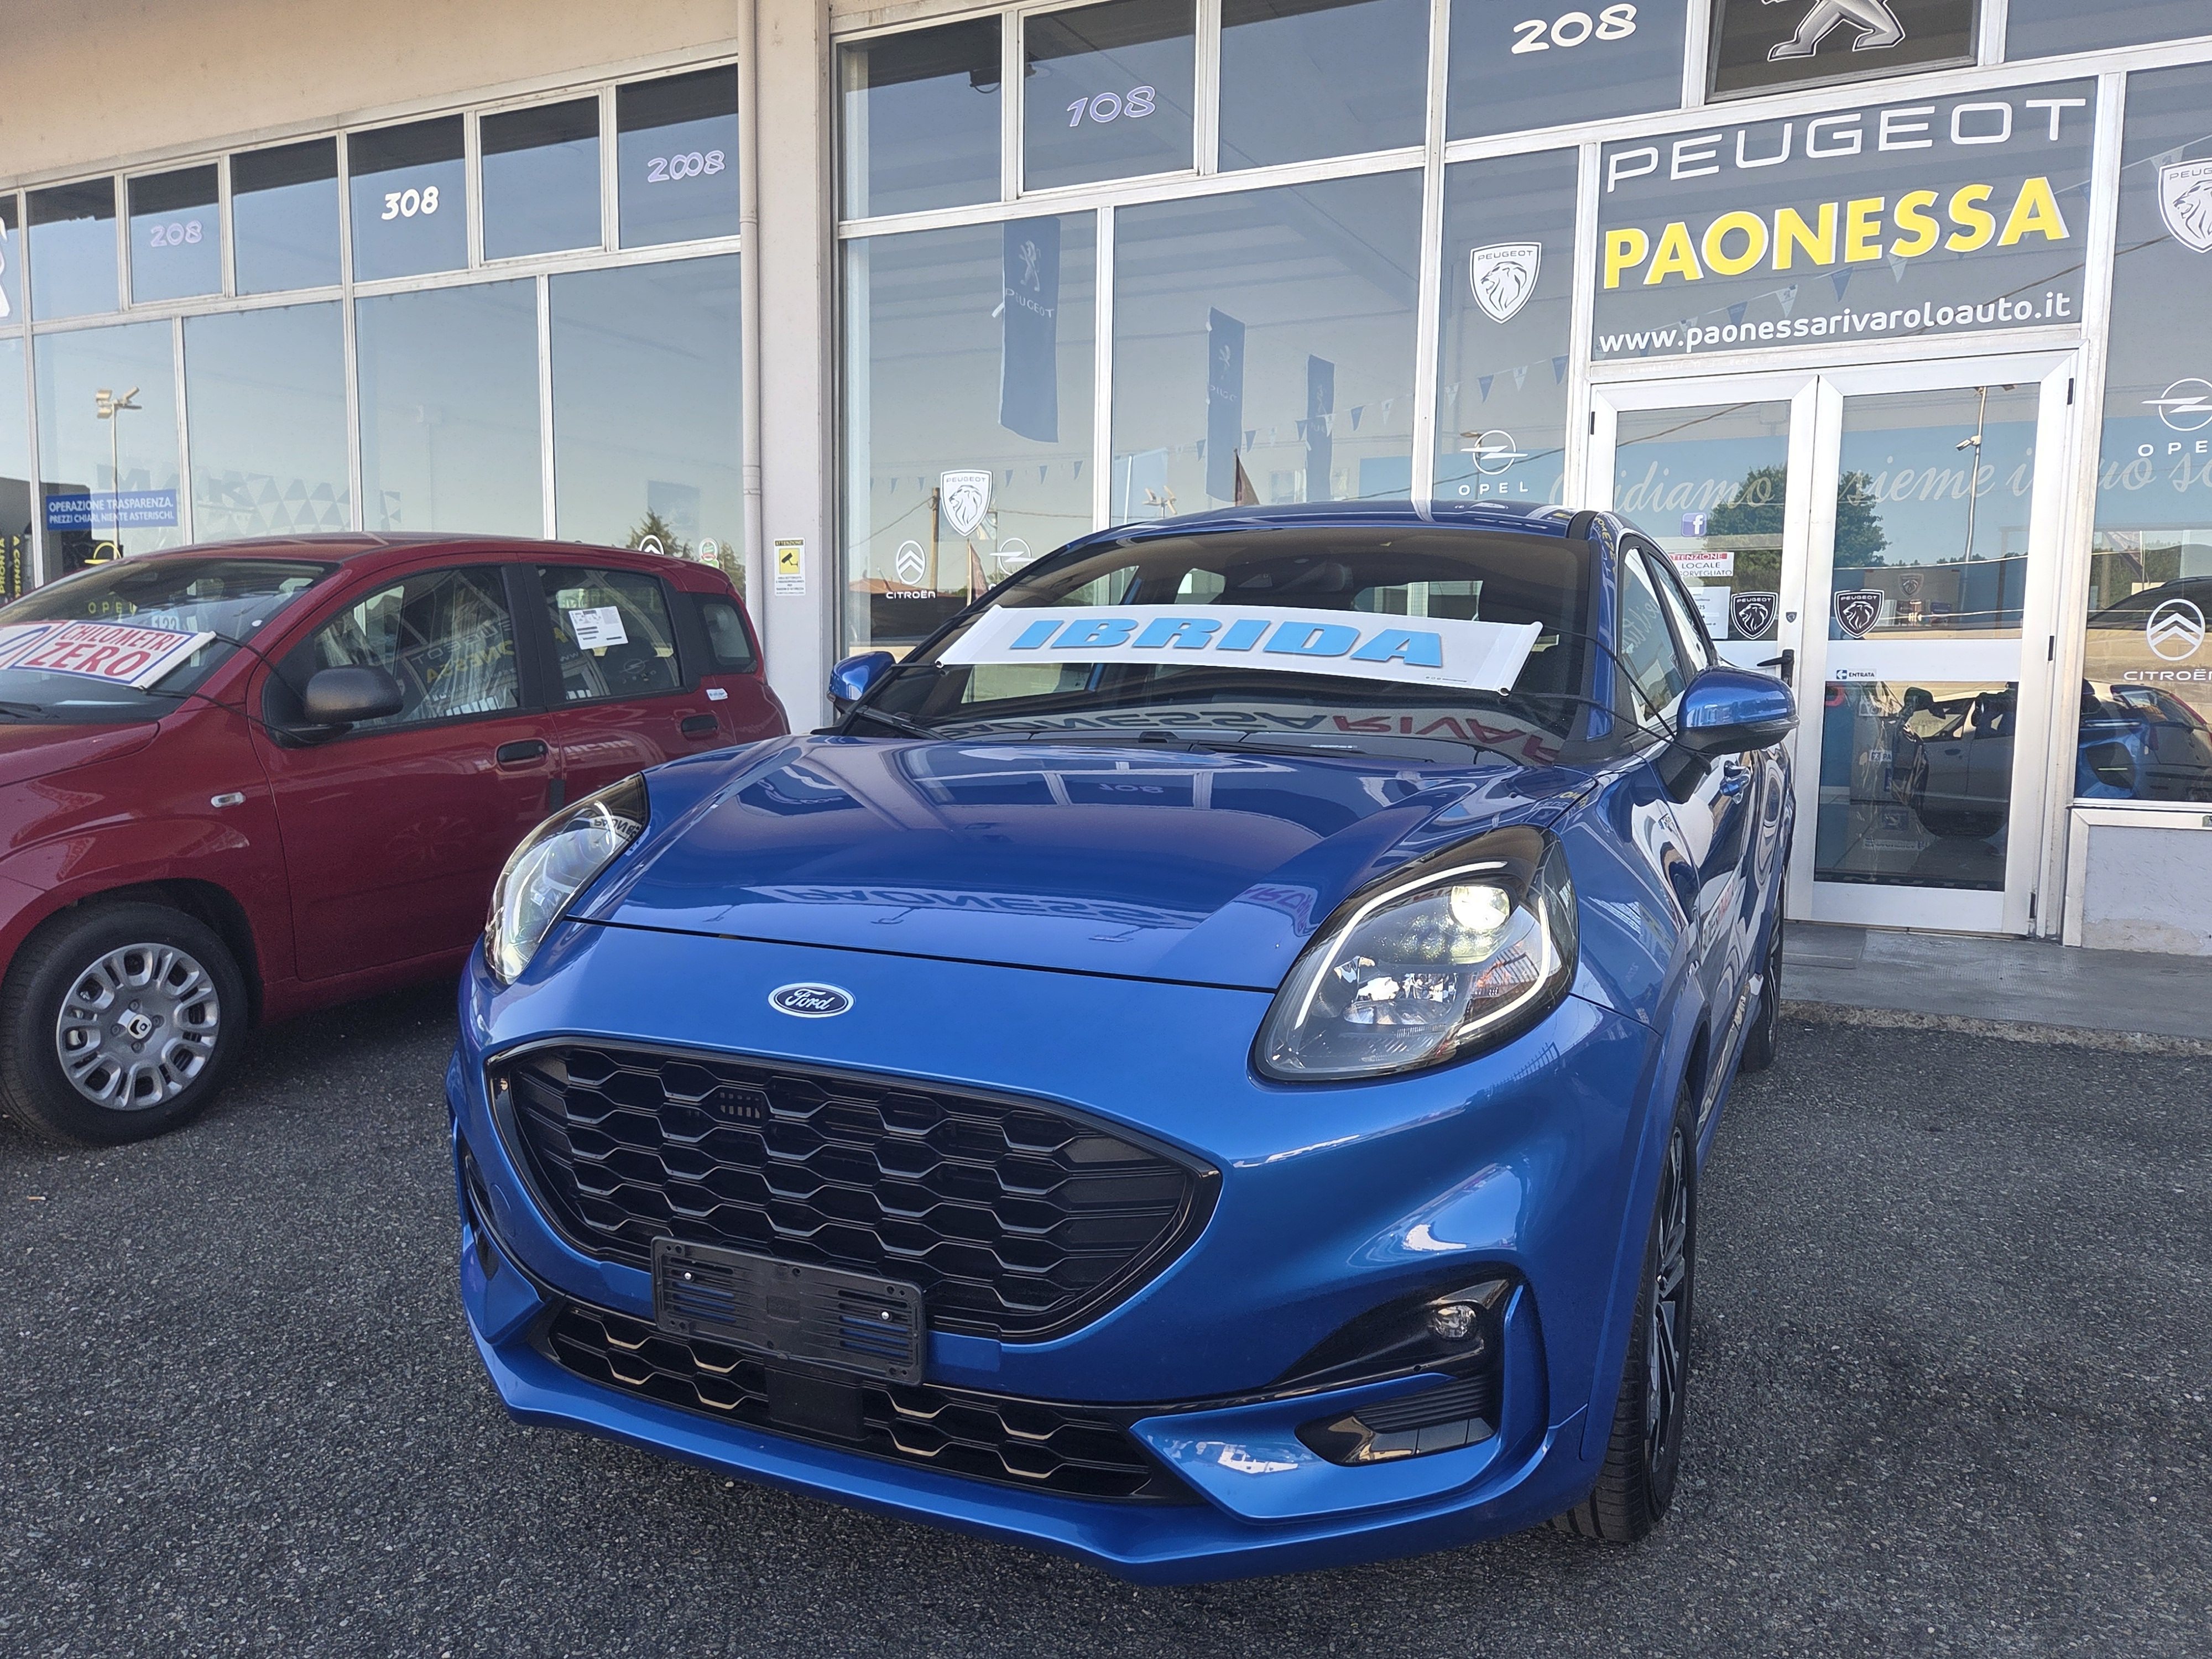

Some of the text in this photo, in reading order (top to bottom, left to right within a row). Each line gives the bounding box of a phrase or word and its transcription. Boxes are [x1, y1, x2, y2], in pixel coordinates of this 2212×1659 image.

[1511, 3, 1637, 54] 208
[1066, 86, 1156, 127] 108
[1606, 98, 2086, 192] PEUGEOT
[647, 150, 726, 184] 2008
[2169, 167, 2212, 180] PEUG
[381, 186, 440, 221] 308
[150, 219, 202, 248] 208
[1603, 176, 2070, 289] PAONESSA
[1478, 250, 1533, 262] PEUGEOT
[1599, 291, 2071, 353] www.paonessarivaroloauto.it
[2138, 440, 2208, 457] OPE
[1458, 480, 1528, 495] OPEL
[1548, 461, 1775, 513] idiamo
[1838, 456, 1995, 506] sieme
[49, 499, 104, 512] OPERAZIONE
[60, 624, 182, 652] CHILOMETRI
[1009, 617, 1442, 668] IBRIDA
[24, 642, 151, 676] ZERO
[2124, 669, 2212, 681] CITROË
[785, 988, 835, 1010] Ford
